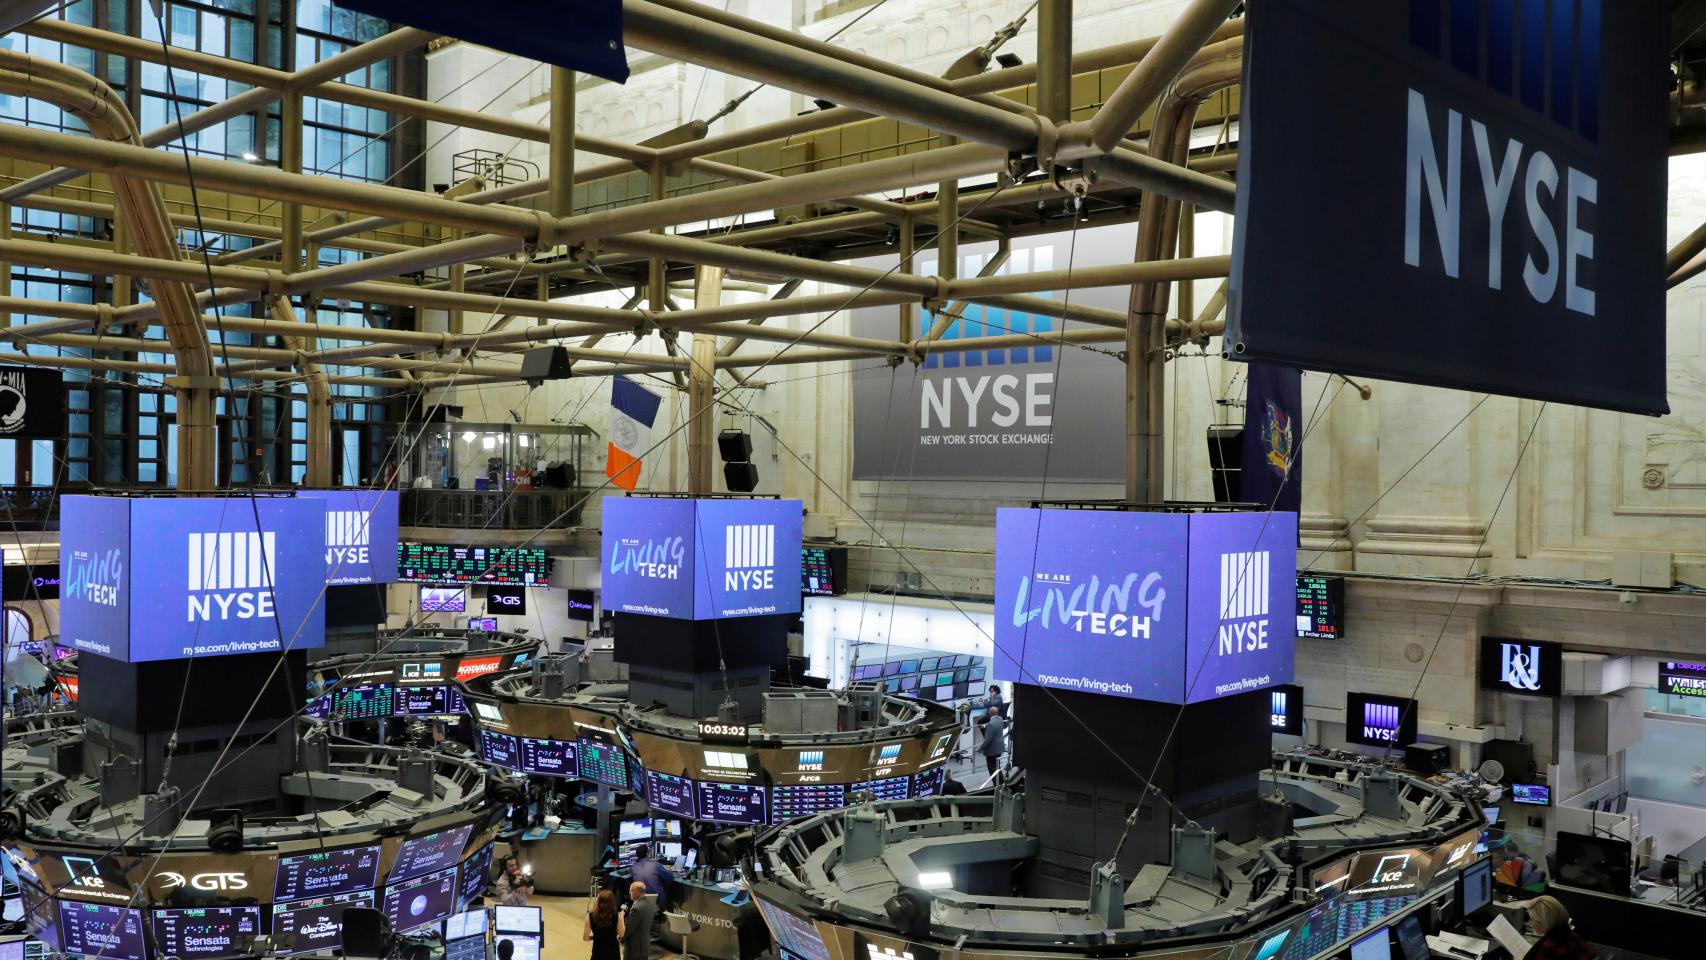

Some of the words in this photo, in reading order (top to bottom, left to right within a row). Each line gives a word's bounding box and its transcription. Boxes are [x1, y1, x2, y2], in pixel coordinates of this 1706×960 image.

[1404, 87, 1598, 317] NYSE
[921, 373, 1054, 429] NYSE
[920, 434, 940, 445] NEW
[943, 434, 966, 445] YORK
[969, 433, 999, 444] STOCK
[1002, 433, 1053, 444] EXCHANGE
[610, 536, 685, 576] LIVING
[66, 548, 122, 600] LIVING
[639, 562, 678, 580] TECH
[1053, 574, 1071, 582] ARE
[725, 569, 774, 592] NYSE
[88, 582, 117, 607] TECH
[502, 596, 521, 605] GTS
[1013, 571, 1166, 630] LIVING
[187, 592, 276, 622] NYSE
[623, 604, 669, 615] nyse.com/living-tech
[722, 605, 776, 617] nyse.com/living-tech
[1071, 610, 1151, 639] TECH
[1219, 619, 1269, 656] NYSE
[183, 639, 280, 656] nyse.com/living-tech
[1038, 673, 1133, 695] nyse.com/living-tech
[1215, 674, 1270, 695] nyse.com/living-tech
[1672, 684, 1706, 696] Access
[1271, 714, 1286, 727] SE
[699, 724, 746, 736] 10:03:02
[798, 763, 823, 771] NYSE
[877, 756, 898, 766] NYSE
[875, 768, 892, 776] UTP
[718, 802, 747, 811] Sensata
[412, 851, 445, 866] Sensata
[191, 872, 248, 891] GTS
[691, 913, 714, 926] YORK
[184, 936, 230, 946] Sensata
[309, 930, 337, 939] Company
